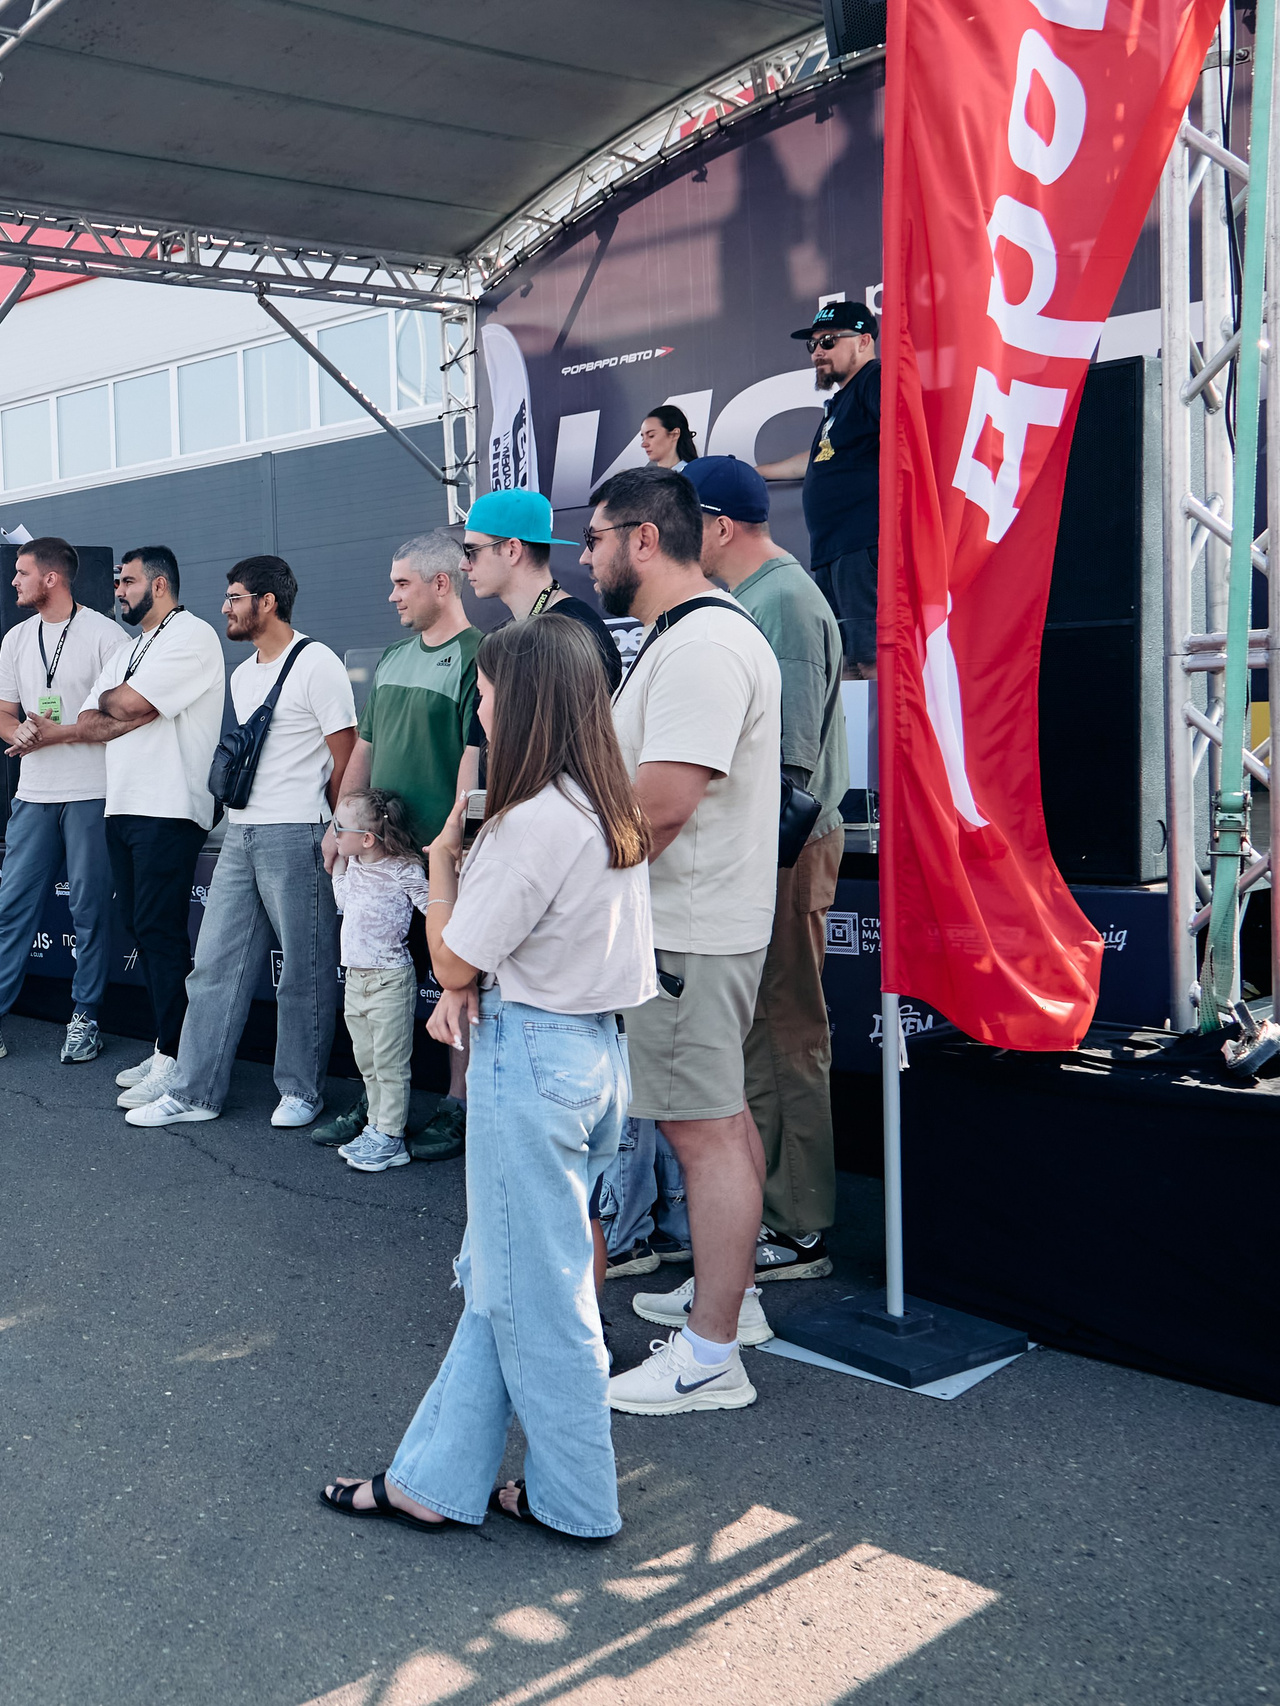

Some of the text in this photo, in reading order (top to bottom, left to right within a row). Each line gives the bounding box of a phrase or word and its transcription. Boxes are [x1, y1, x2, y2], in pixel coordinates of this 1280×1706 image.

[561, 349, 653, 376] ФОРВАРД АВТО
[951, 0, 1109, 544] дро
